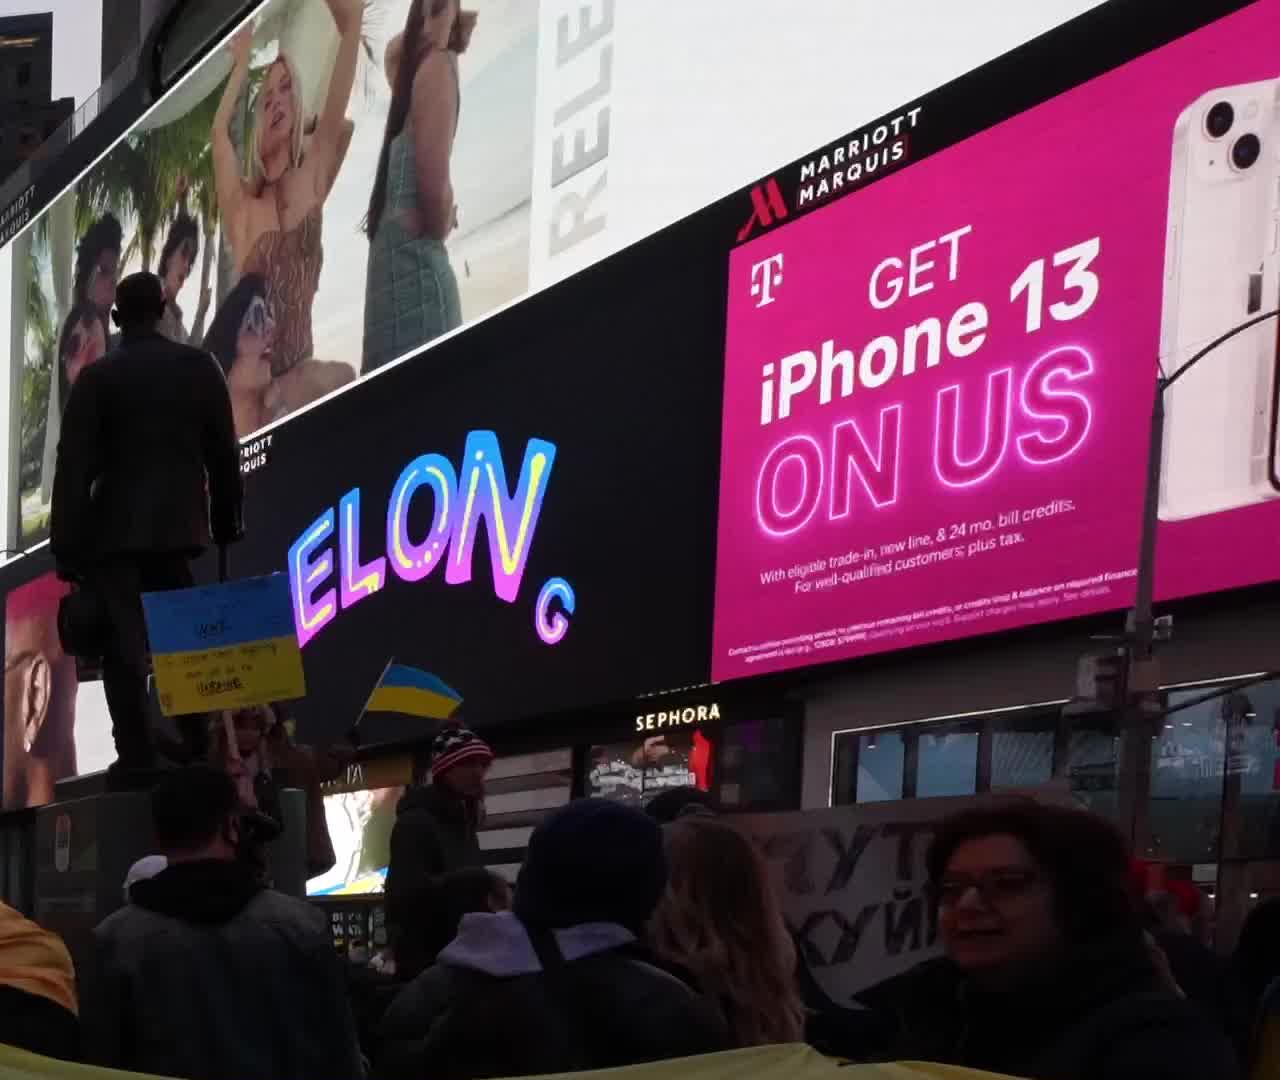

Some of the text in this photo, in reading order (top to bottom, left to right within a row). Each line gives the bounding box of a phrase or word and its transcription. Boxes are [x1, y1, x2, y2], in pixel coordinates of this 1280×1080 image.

[798, 141, 906, 206] MARQUIS
[800, 107, 922, 181] MARRIOTT
[867, 225, 973, 310] GET
[760, 236, 1100, 425] iPhone 13
[756, 342, 1094, 537] ON US
[759, 567, 786, 585] With
[936, 527, 946, 543] &
[948, 522, 966, 540] 24
[997, 509, 1020, 528] bill
[1021, 499, 1076, 523] credits.
[794, 581, 812, 594] For
[967, 536, 997, 557] plus
[999, 531, 1025, 547] tax.
[635, 702, 721, 732] SEPHORA
